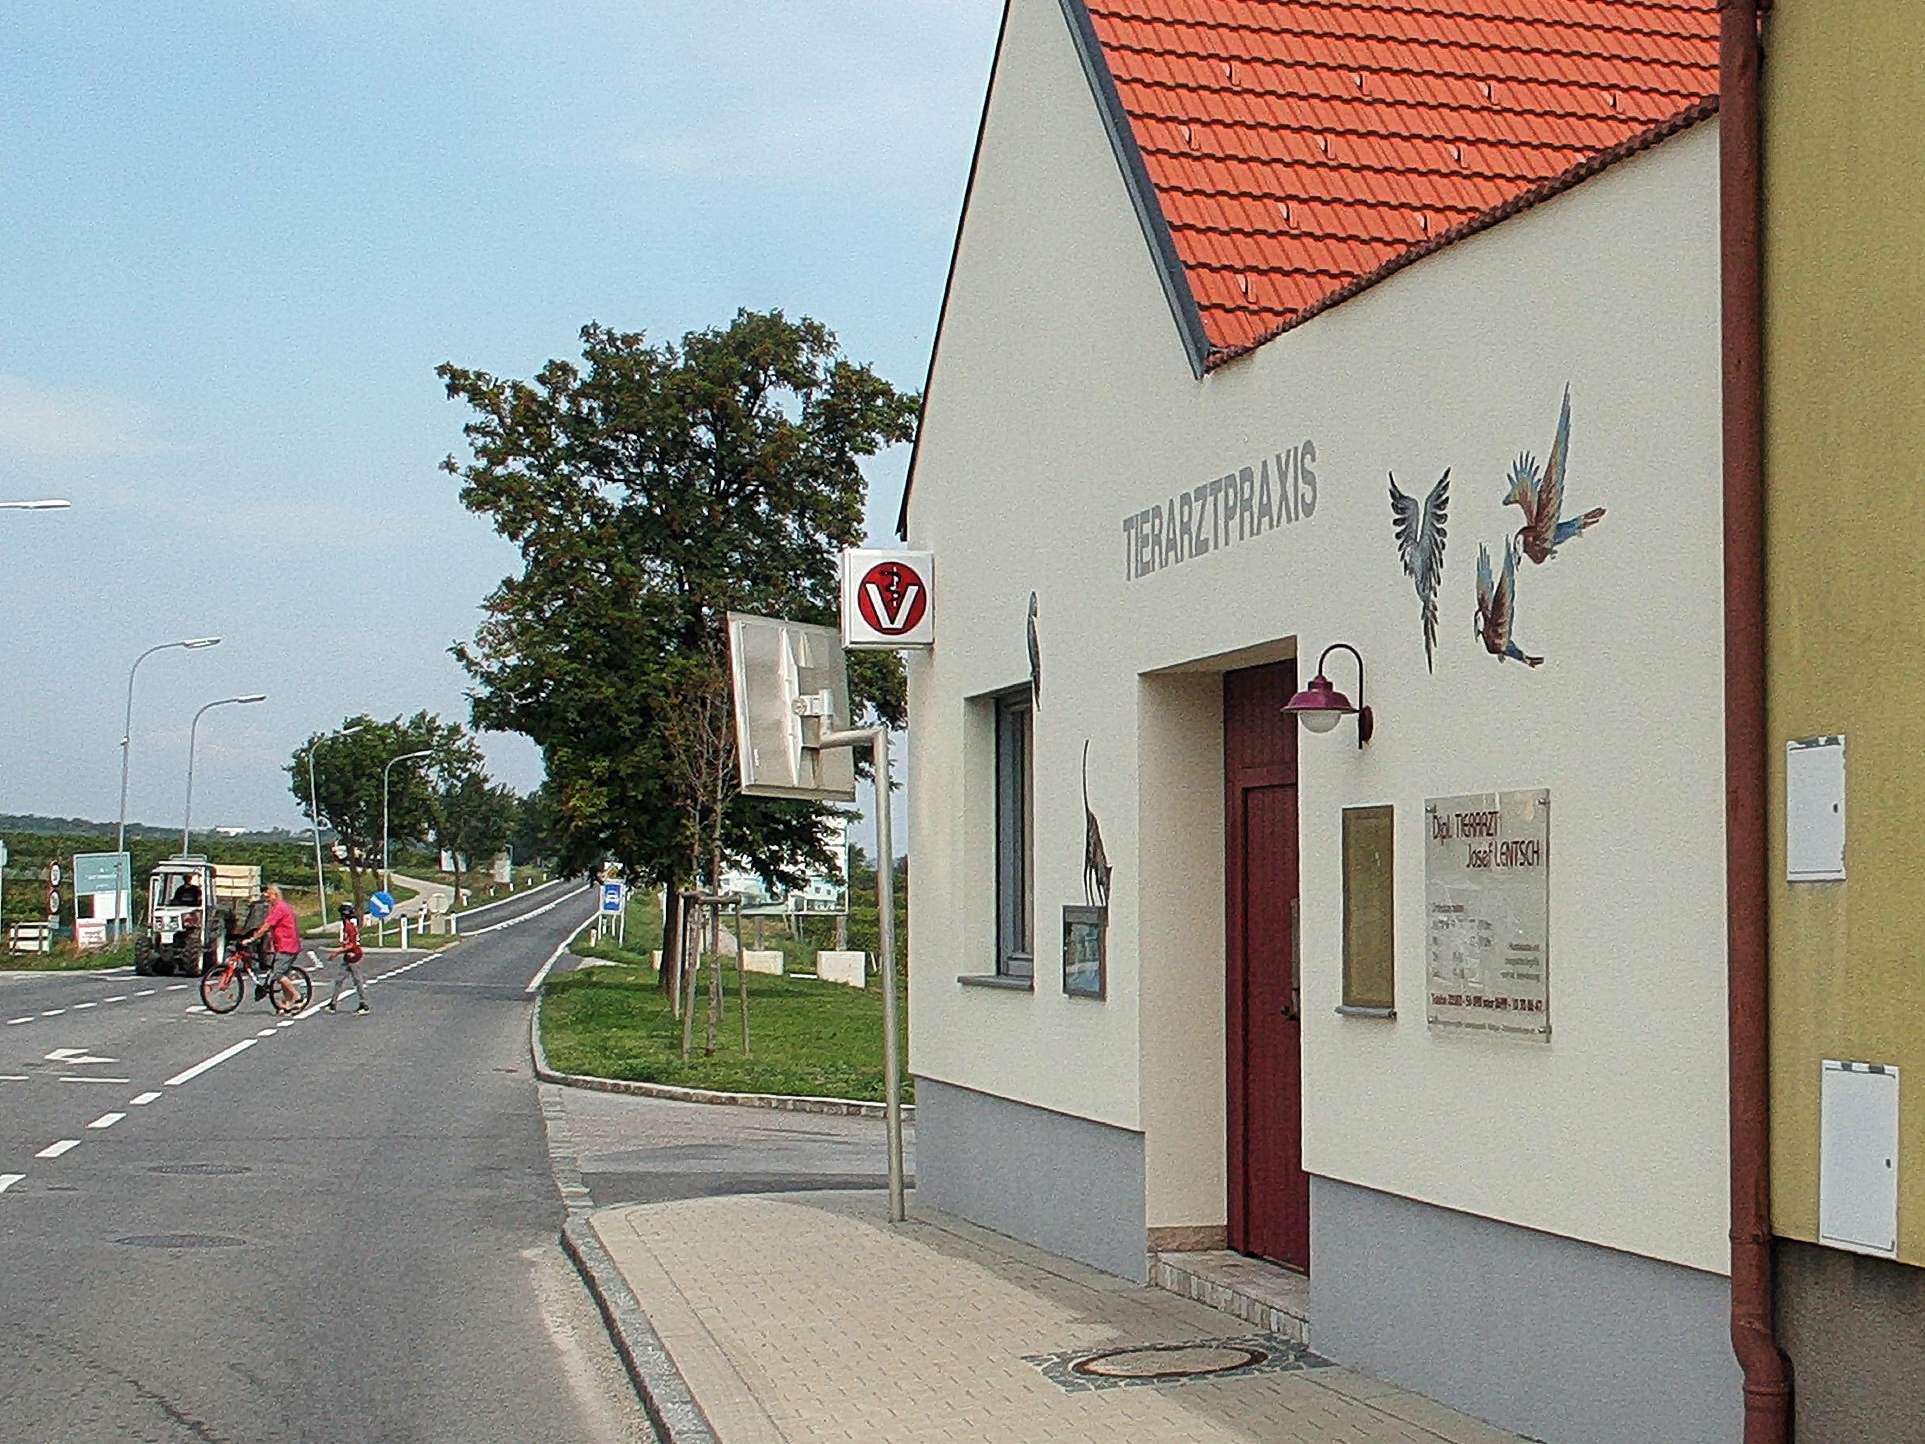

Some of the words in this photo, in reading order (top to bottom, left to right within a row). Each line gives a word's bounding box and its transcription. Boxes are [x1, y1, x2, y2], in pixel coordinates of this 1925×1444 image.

[1122, 439, 1318, 582] TIERARZTPRAXIS
[864, 582, 920, 630] V
[1454, 811, 1499, 838] TIERARZT
[1466, 841, 1493, 868] Josef
[1494, 839, 1541, 867] LENTSCH
